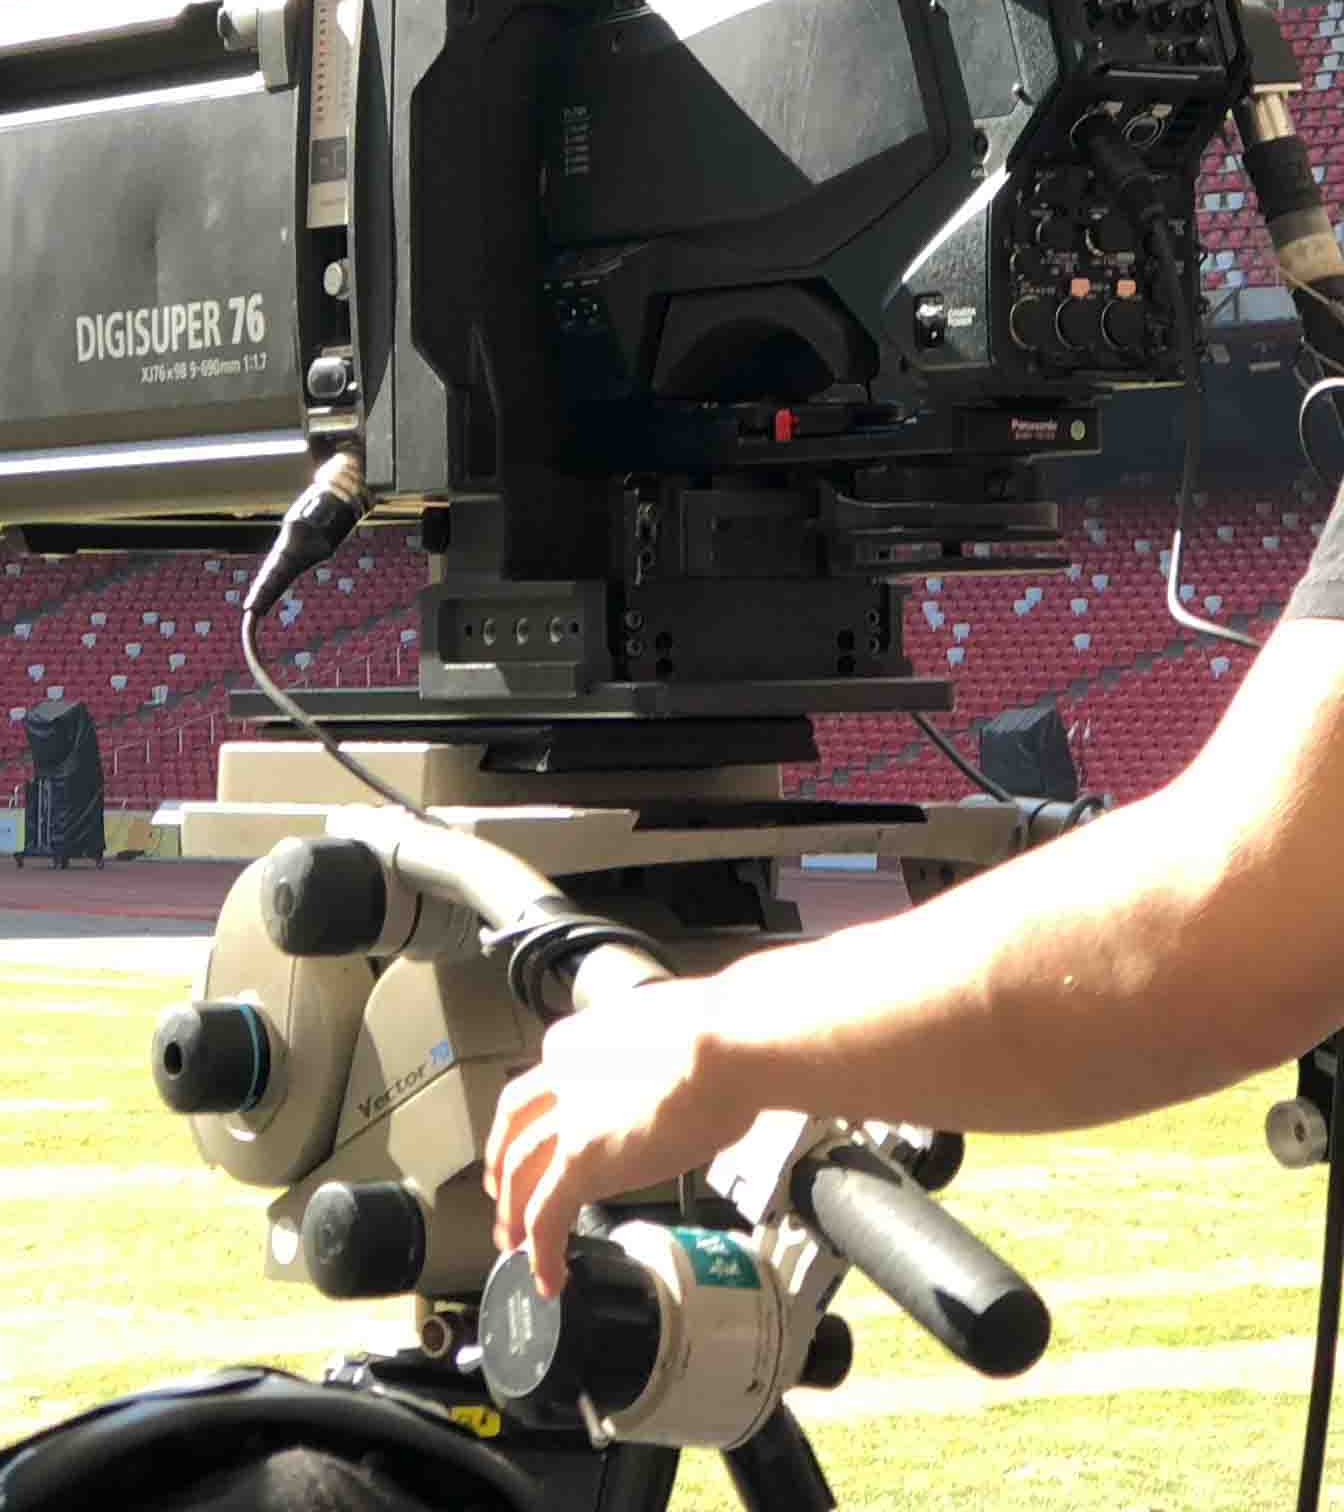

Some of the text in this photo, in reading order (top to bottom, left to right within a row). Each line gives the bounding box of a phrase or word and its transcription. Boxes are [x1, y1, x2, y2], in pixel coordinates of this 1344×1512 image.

[76, 293, 265, 362] DIGISUPER 76
[358, 1064, 426, 1119] Vector
